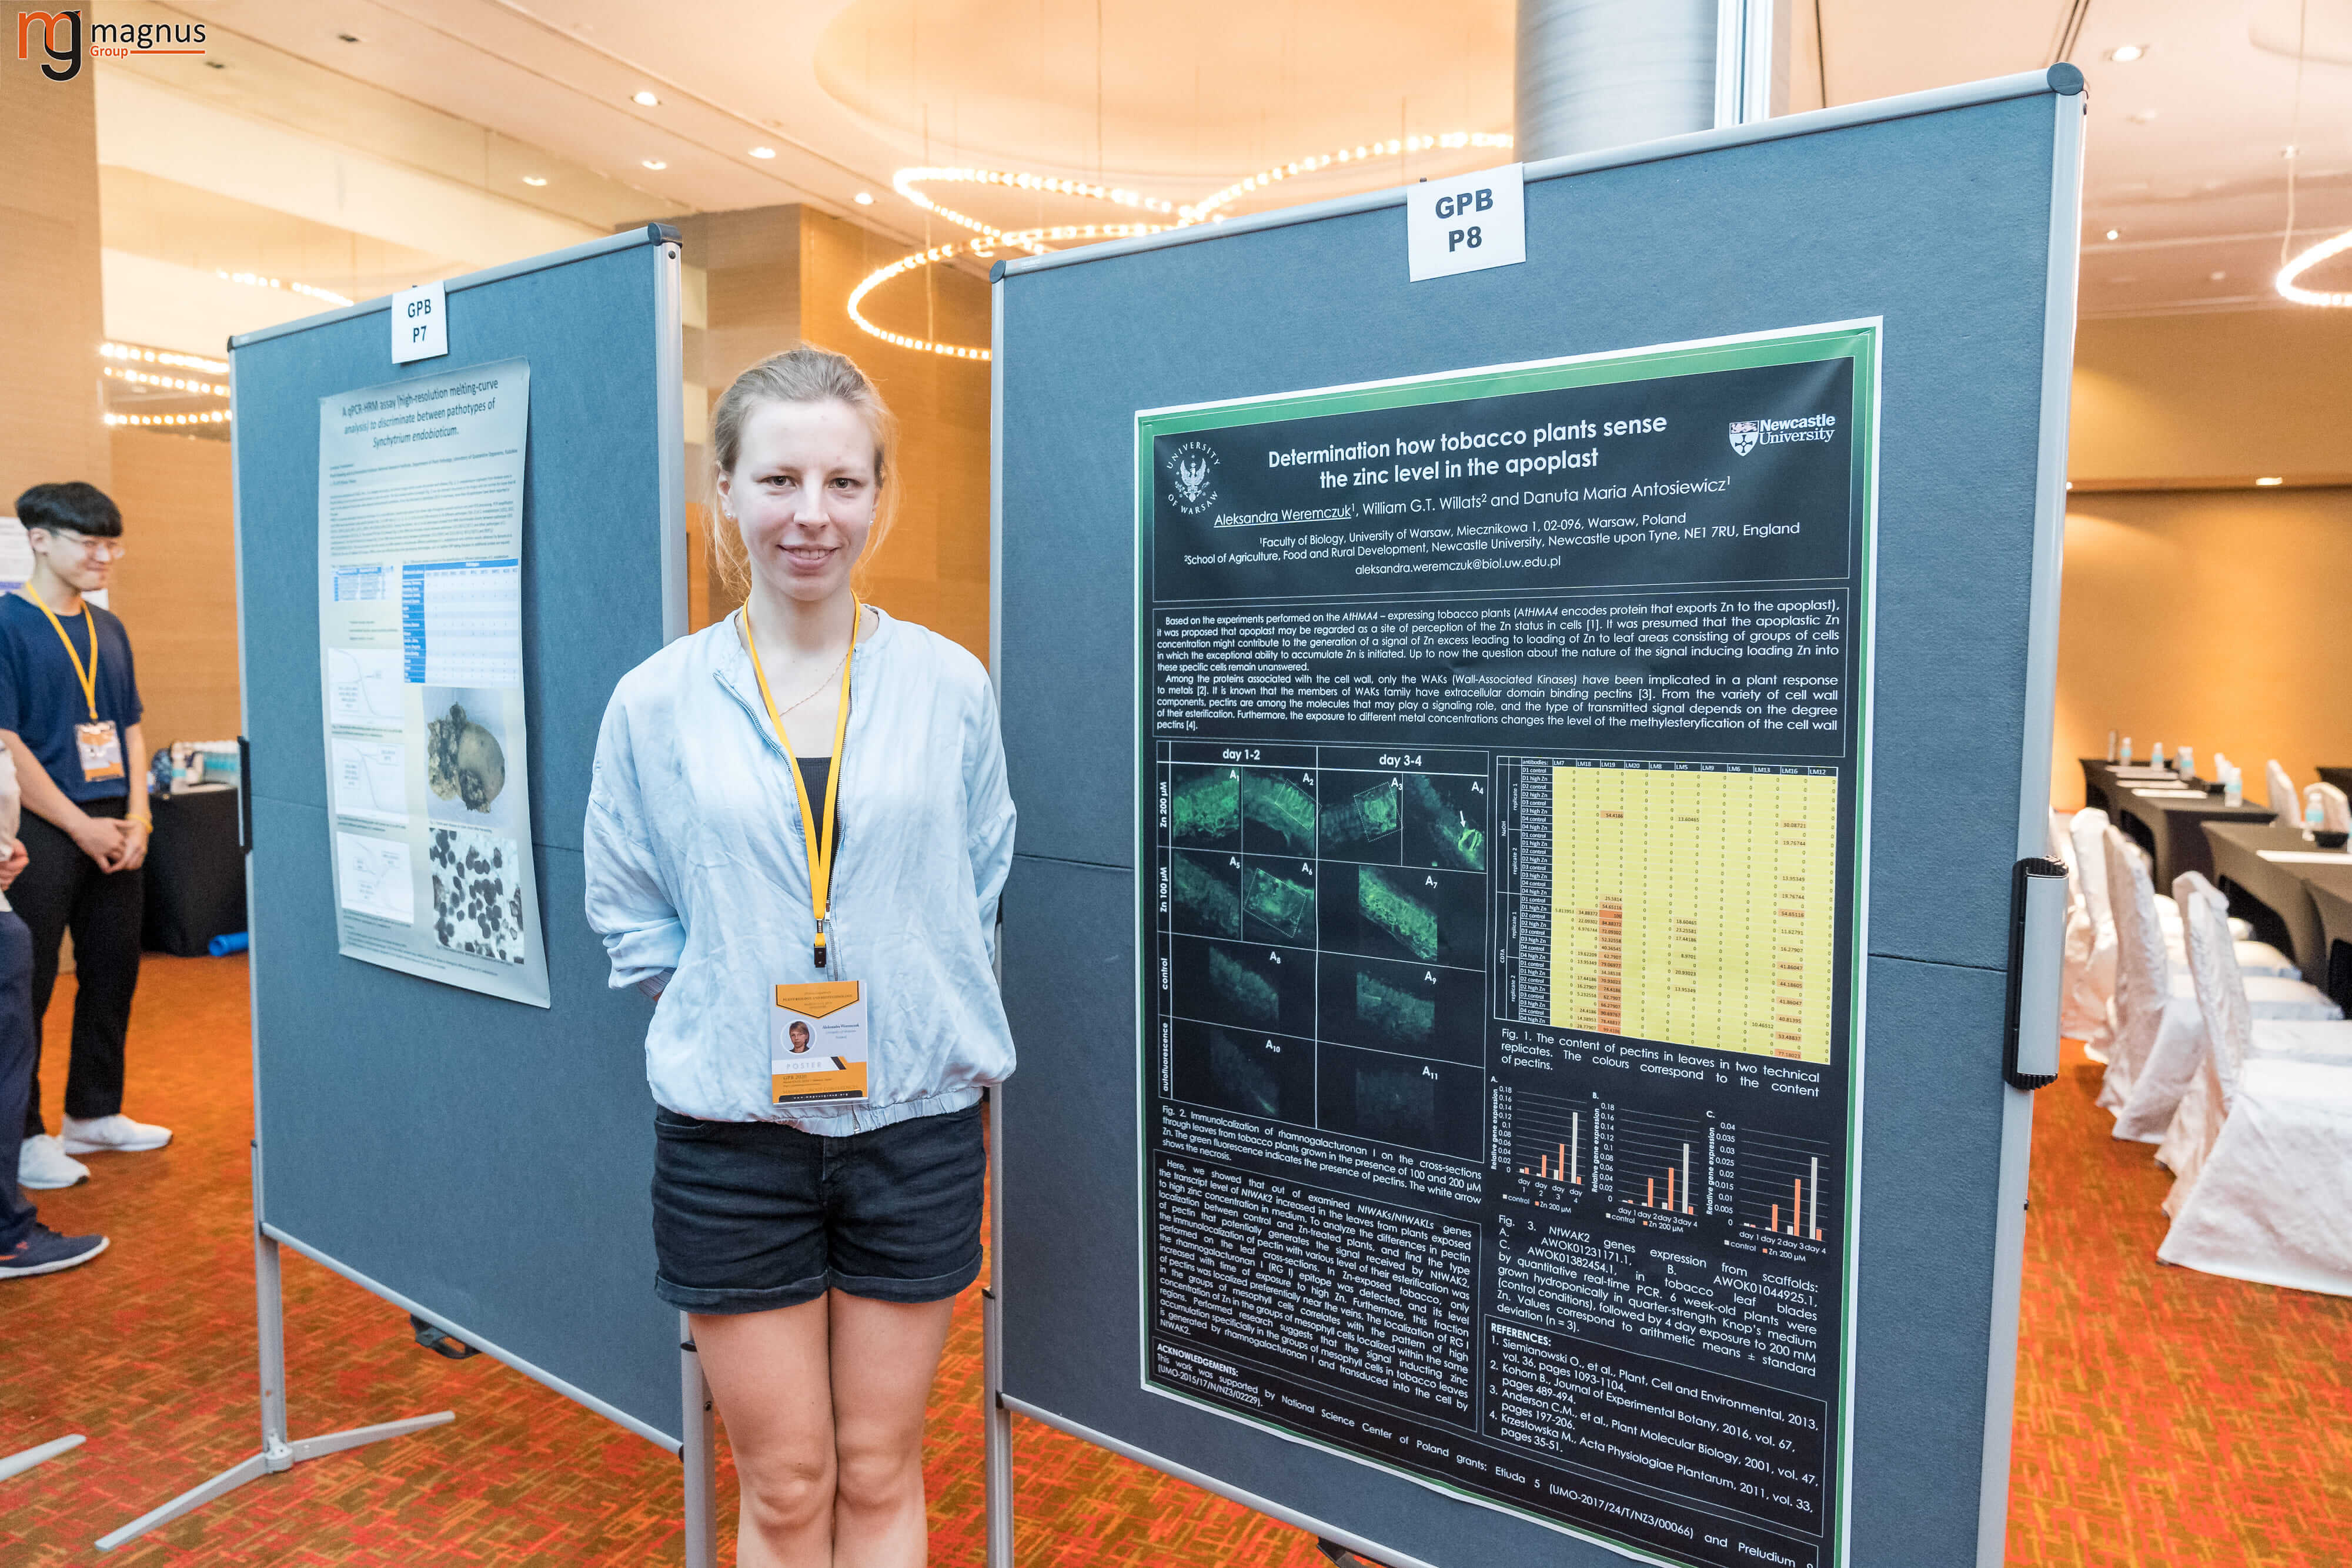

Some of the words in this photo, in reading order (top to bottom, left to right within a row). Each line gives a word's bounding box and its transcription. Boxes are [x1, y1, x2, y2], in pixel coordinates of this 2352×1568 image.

[1435, 188, 1494, 219] GPB
[1448, 226, 1482, 253] P8
[407, 299, 432, 318] GPB
[413, 325, 427, 343] P7
[1759, 413, 1836, 433] Newcastle
[1759, 427, 1836, 446] University
[1167, 442, 1221, 469] UNIVERSITY
[1268, 442, 1390, 468] Determination
[1396, 437, 1436, 456] how
[1440, 430, 1527, 452] tobacco
[1534, 419, 1597, 448] plants
[1603, 416, 1668, 437] sense
[1319, 470, 1348, 489] the
[1353, 470, 1389, 486] zinc
[1395, 460, 1439, 483] level
[1445, 463, 1462, 479] in
[1467, 457, 1499, 477] the
[1505, 447, 1599, 477] apoplast
[1168, 494, 1178, 506] OF
[1181, 491, 1218, 515] WARSAW
[1214, 510, 1278, 526] Aleksandra
[1362, 501, 1406, 516] William
[1410, 498, 1435, 513] G.T.
[1491, 492, 1519, 507] and
[1524, 488, 1579, 505] Danuta
[1583, 487, 1627, 501] Maria
[1298, 534, 1308, 546] of
[1309, 534, 1344, 546] Biology,
[1349, 530, 1394, 543] University
[1396, 529, 1407, 540] of
[1409, 528, 1454, 539] Warsaw,
[1456, 523, 1528, 536] Miecznikowa
[1532, 521, 1541, 533] 1,
[1543, 518, 1584, 531] 02-096,
[1588, 517, 1639, 529] Warsaw,
[1642, 511, 1686, 526] Poland
[1217, 553, 1227, 563] of
[1228, 551, 1281, 565] Agriculture,
[1283, 549, 1307, 560] Food
[1309, 547, 1329, 559] and
[1331, 546, 1355, 558] Rural
[1357, 542, 1429, 557] Development,
[1431, 539, 1488, 552] Newcastle
[1491, 536, 1545, 550] University,
[1548, 532, 1611, 546] Newcastle
[1613, 533, 1646, 546] upon
[1648, 530, 1681, 544] Tyne,
[1684, 527, 1706, 539] NE1
[1711, 525, 1739, 538] 7RU,
[1743, 521, 1800, 538] England
[1355, 555, 1561, 575] aleksandra.weremczuk@biol.uw.edu.pl
[1165, 616, 1189, 626] Based
[1202, 616, 1215, 624] the
[1216, 614, 1264, 626] experiments
[1265, 613, 1311, 625] performed
[1325, 612, 1341, 621] the
[1387, 611, 1435, 622] expressing
[1437, 609, 1479, 619] tobacco
[1481, 607, 1511, 620] plants
[1561, 605, 1608, 617] encodes
[1609, 604, 1648, 617] protein
[1650, 603, 1673, 614] that
[1676, 602, 1718, 616] exports
[1720, 601, 1734, 613] Zn
[1737, 601, 1750, 612] to
[1753, 601, 1774, 611] the
[1776, 599, 1840, 613] apoplast),
[1222, 748, 1242, 762] day
[1244, 749, 1261, 760] 1-2
[1379, 754, 1401, 768] day
[1403, 754, 1422, 767] 3-4
[1160, 818, 1167, 828] Zn
[1160, 901, 1167, 912] Zn
[786, 1061, 822, 1070] POSTER
[1502, 1028, 1519, 1041] Fig.
[1524, 1031, 1532, 1041] 1.
[1536, 1032, 1555, 1044] The
[1558, 1038, 1600, 1051] content
[1604, 1043, 1616, 1053] of
[1620, 1047, 1659, 1060] pectins
[1663, 1053, 1673, 1062] in
[1678, 1053, 1715, 1068] leaves
[1719, 1061, 1730, 1070] in
[1735, 1061, 1758, 1074] two
[1762, 1065, 1820, 1083] technical
[1498, 1214, 1515, 1228] Fig.
[1527, 1221, 1536, 1231] 3.
[1548, 1226, 1590, 1243] NtWAK2
[1603, 1239, 1636, 1253] genes
[1649, 1249, 1707, 1268] expression
[1721, 1262, 1748, 1277] from
[1762, 1273, 1818, 1292] scaffolds:
[1491, 1322, 1552, 1346] REFERENCES:
[1157, 1343, 1239, 1376] ACKNOWLEDGEMENTS:
[1492, 1335, 1499, 1346] 1.
[1502, 1338, 1568, 1363] Siemianowski
[1569, 1356, 1585, 1369] O.,
[1587, 1362, 1598, 1372] et
[1600, 1365, 1616, 1378] al.,
[1619, 1369, 1648, 1386] Plant,
[1651, 1378, 1673, 1392] Cell
[1675, 1385, 1698, 1398] and
[1700, 1389, 1785, 1423] Environmental,
[1788, 1413, 1819, 1431] 2013,
